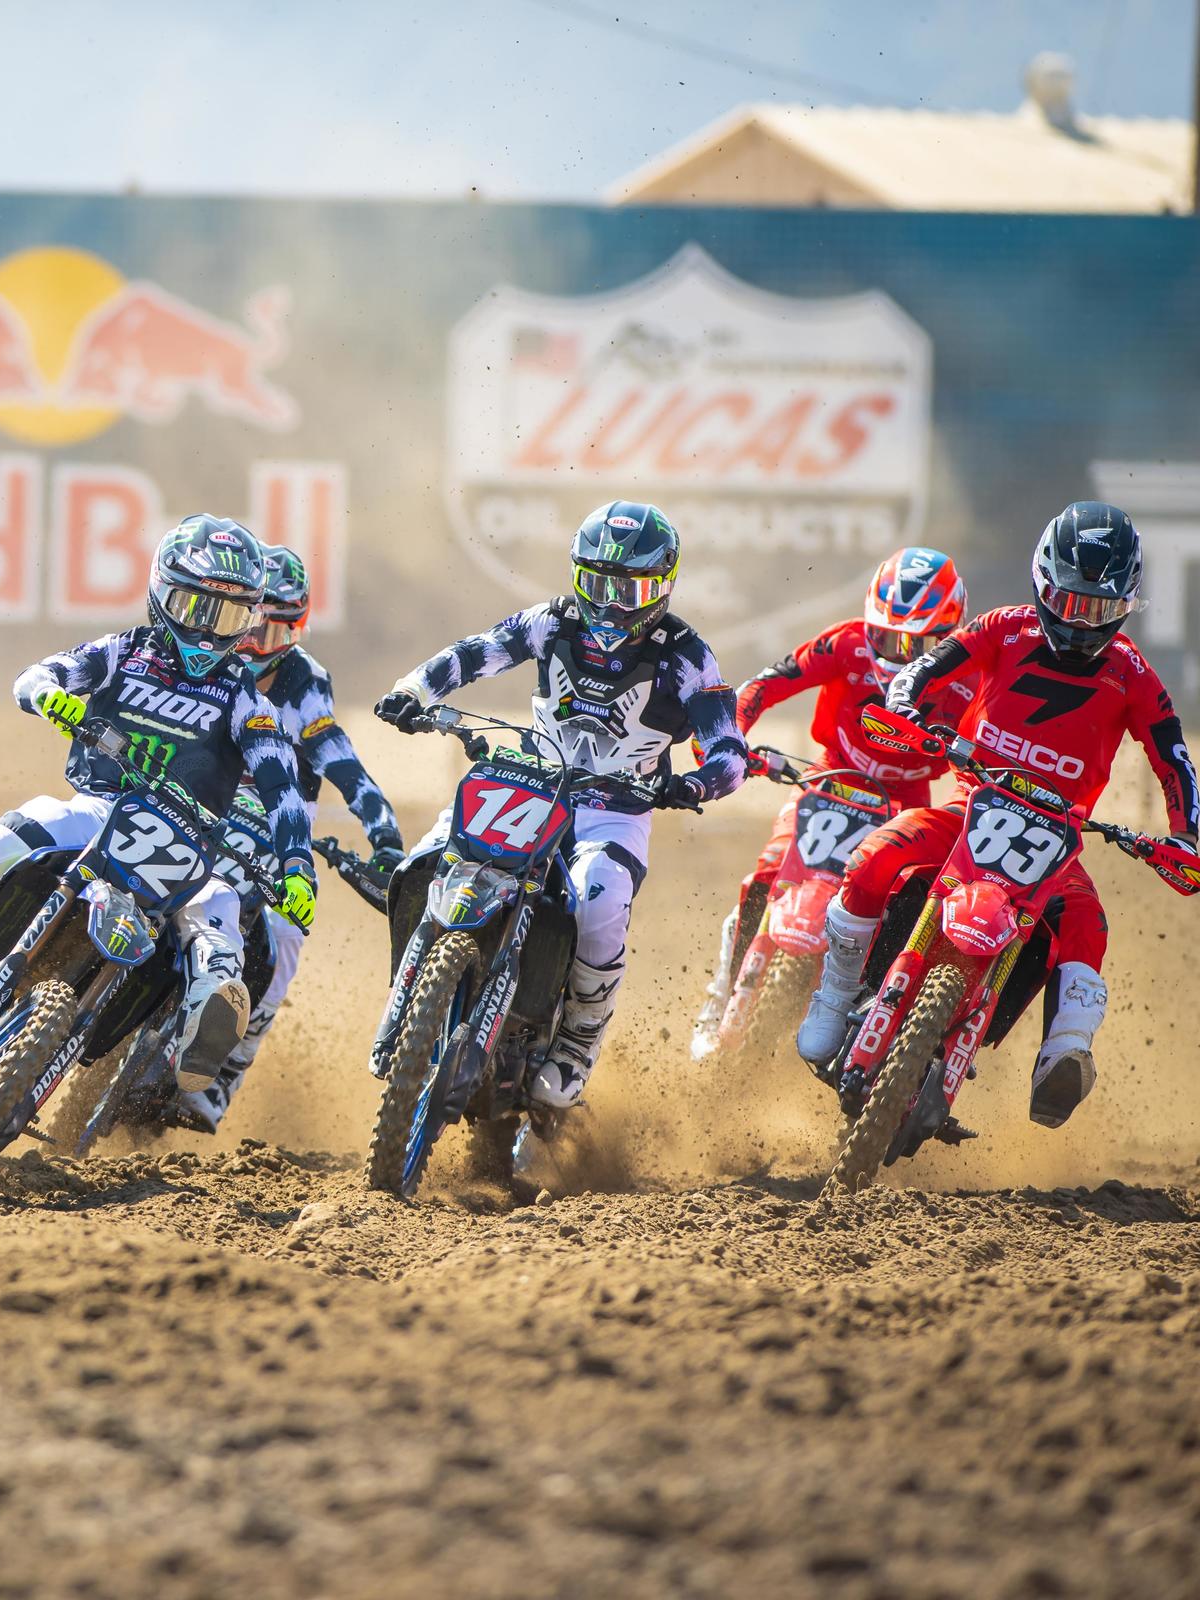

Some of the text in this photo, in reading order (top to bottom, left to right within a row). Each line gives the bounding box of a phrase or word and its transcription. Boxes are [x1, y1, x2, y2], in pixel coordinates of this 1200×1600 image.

[512, 387, 895, 477] LUCAS
[613, 518, 636, 527] BELL
[682, 500, 897, 551] ODUCTS
[58, 467, 341, 621] Bll
[215, 534, 237, 544] BELL
[1078, 538, 1110, 548] HONDA
[1001, 608, 1038, 619] GEIC
[674, 628, 689, 640] thor
[125, 661, 145, 673] 100%
[578, 677, 614, 692] thor
[949, 681, 974, 702] ICO
[117, 677, 222, 731] THOR
[581, 703, 609, 718] YAMAHA
[869, 733, 910, 752] CYCRA
[975, 719, 1085, 780] GEICO
[496, 769, 545, 789] LUCAS OIL
[157, 803, 187, 828] LUCAS
[184, 826, 199, 841] OIL
[464, 787, 552, 850] 14
[828, 802, 872, 822] LUCAS OIL
[1004, 801, 1051, 828] LUCAS OIL
[231, 812, 272, 841] LUCAS OIL
[108, 811, 205, 899] 32
[967, 808, 1067, 885] 83
[982, 872, 1011, 889] SHIFT
[1156, 864, 1194, 891] CYCRA
[948, 922, 996, 948] GEICO
[952, 932, 986, 952] HONDA
[391, 936, 424, 1022] DULOP
[500, 979, 518, 1015] YAMALUBE
[860, 971, 910, 1054] GICO
[943, 1007, 986, 1095] GEICO
